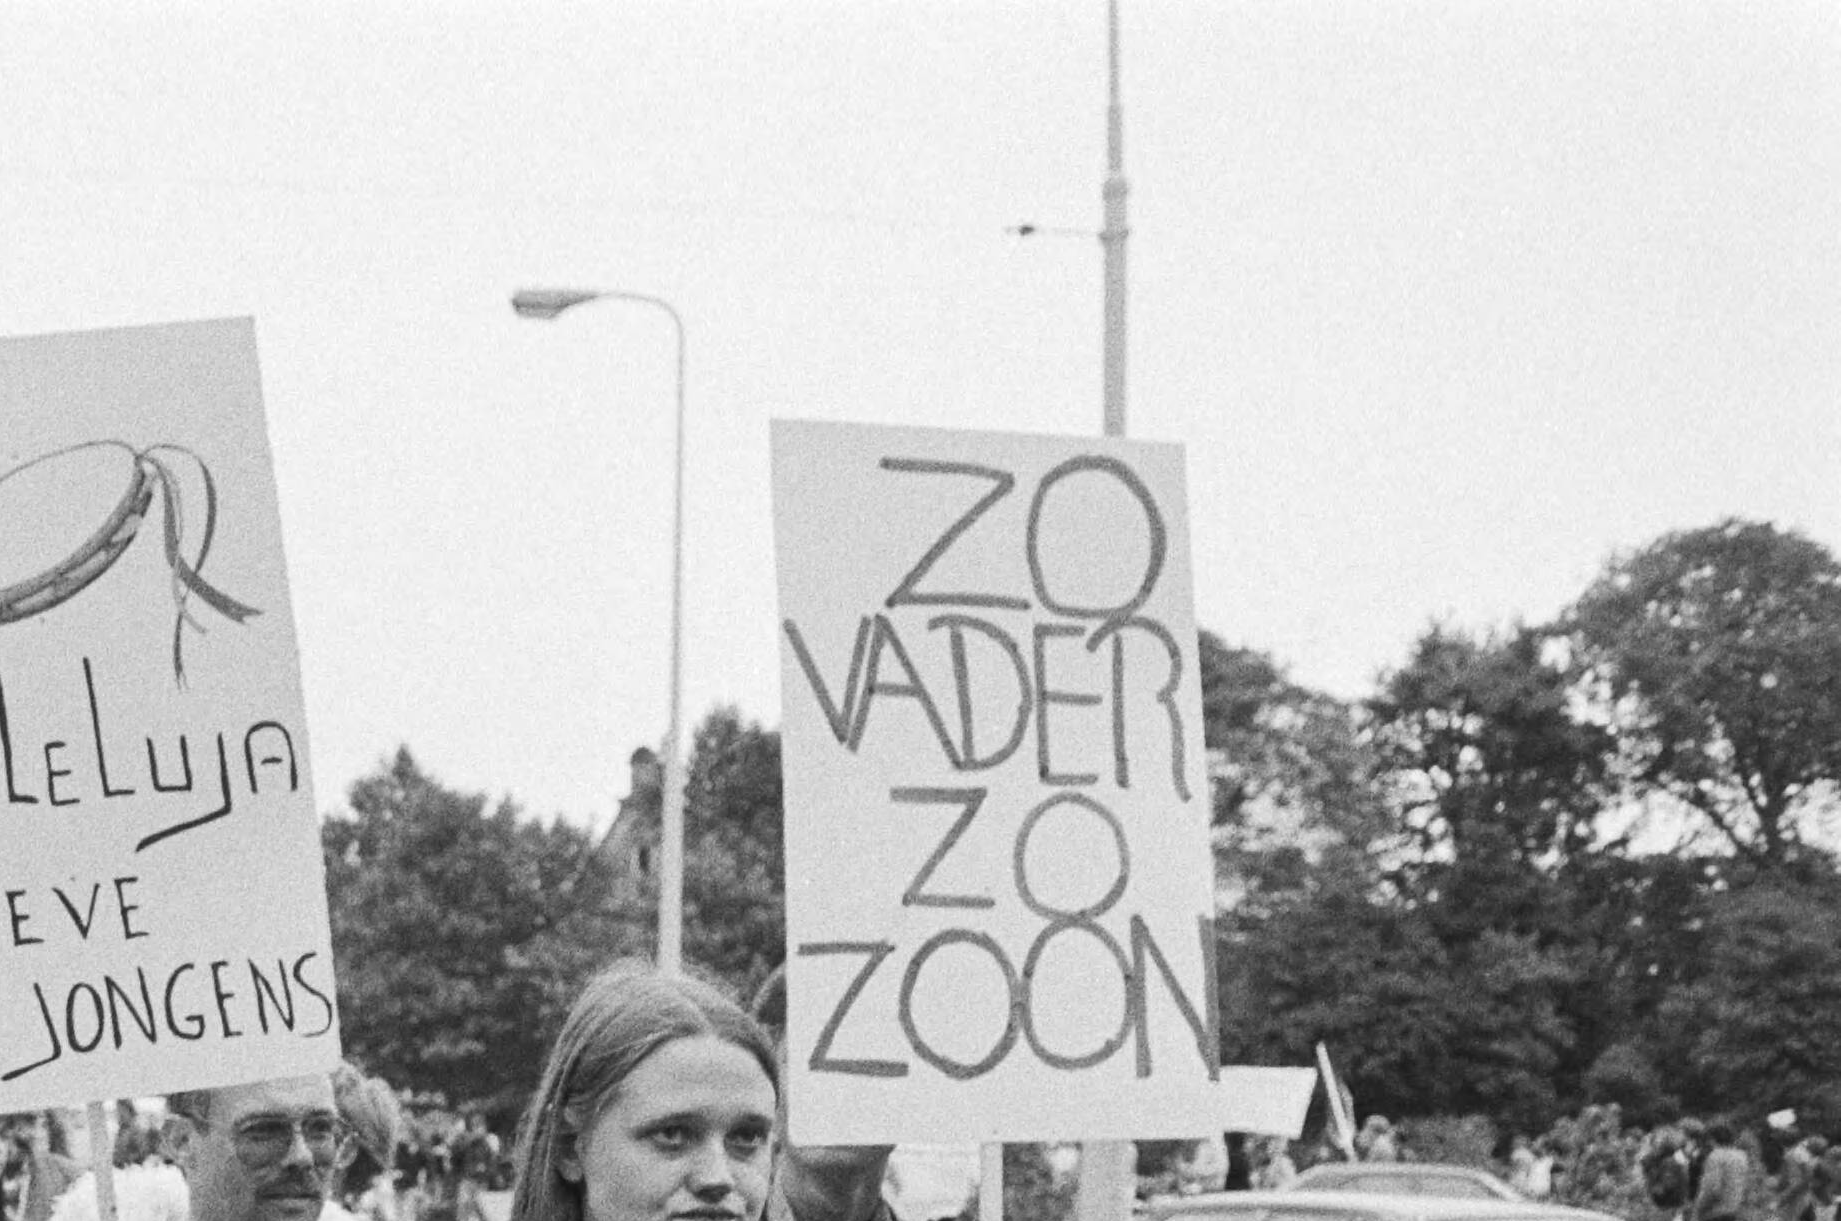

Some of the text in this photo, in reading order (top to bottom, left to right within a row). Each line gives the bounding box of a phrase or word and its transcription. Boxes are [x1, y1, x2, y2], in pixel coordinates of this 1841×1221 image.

[879, 455, 1167, 620] ZO
[784, 612, 1193, 803] VADER
[890, 788, 1131, 918] ZO
[0, 945, 334, 1082] JONGENS
[797, 913, 1221, 1083] ZOON
